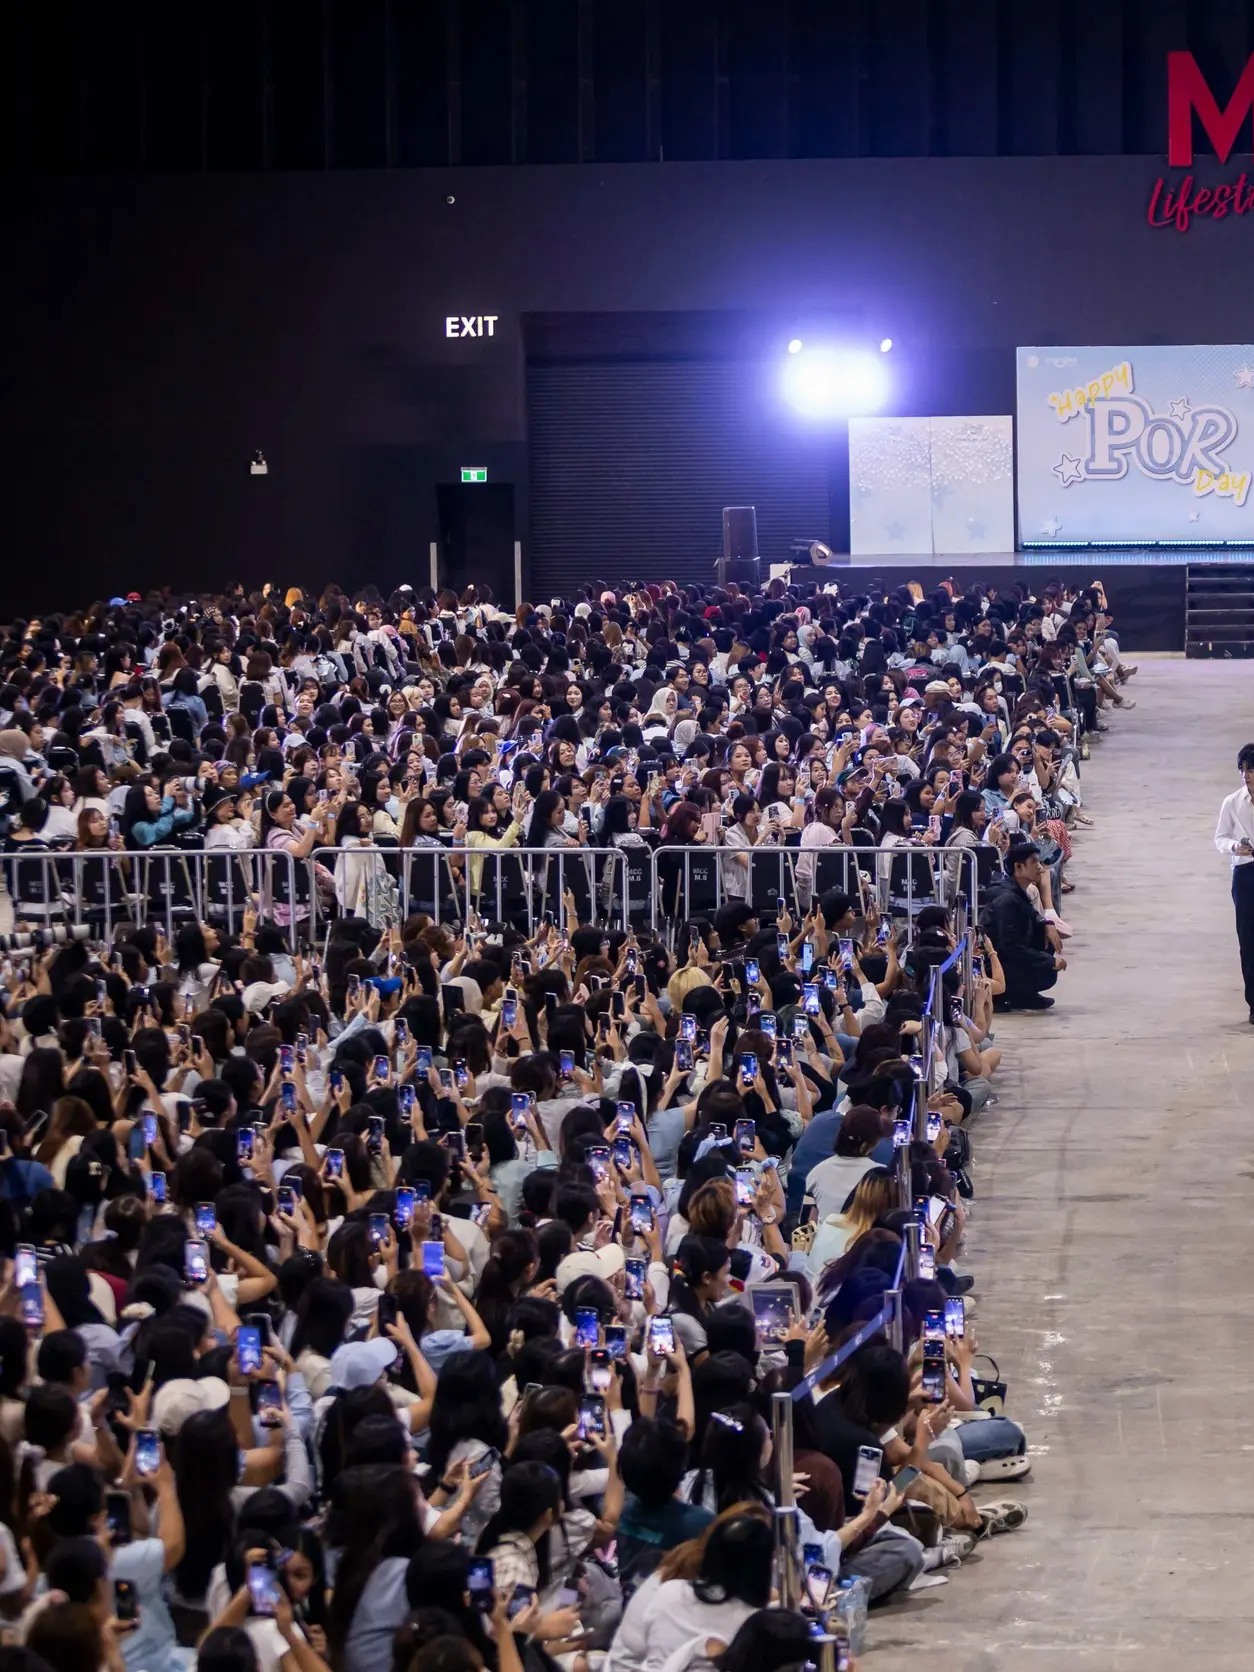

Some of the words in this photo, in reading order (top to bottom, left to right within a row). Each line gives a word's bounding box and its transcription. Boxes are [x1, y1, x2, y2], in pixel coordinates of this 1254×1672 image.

[445, 315, 499, 338] EXIT
[1050, 364, 1129, 417] Happy
[1195, 468, 1247, 501] Day
